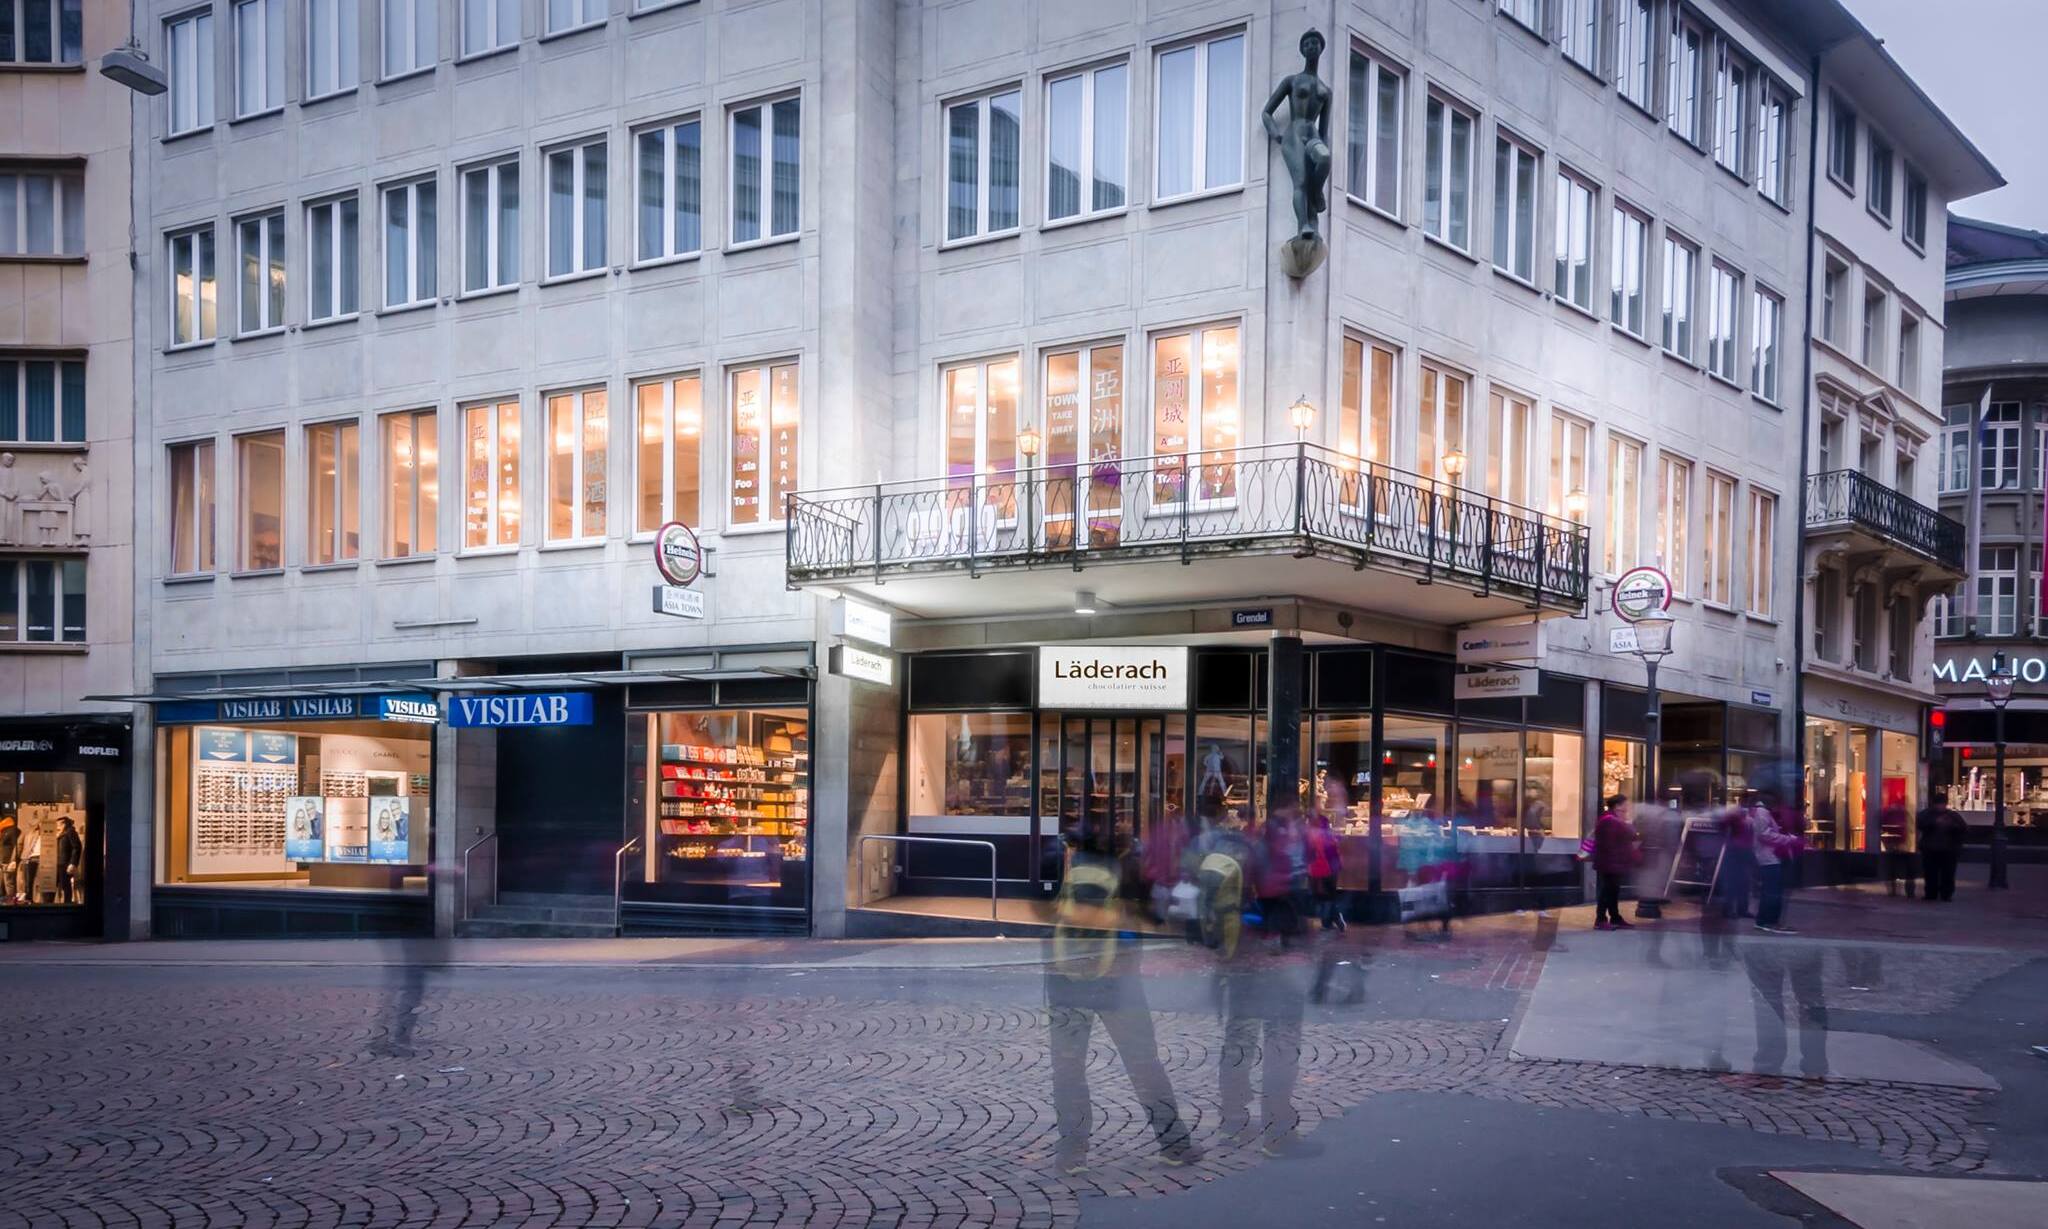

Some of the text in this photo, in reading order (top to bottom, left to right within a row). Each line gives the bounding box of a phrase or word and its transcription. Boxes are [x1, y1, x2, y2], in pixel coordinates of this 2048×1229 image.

[1162, 357, 1184, 424] 亚洲城
[1048, 393, 1079, 408] TOWN
[1052, 411, 1073, 420] TAKE
[1091, 369, 1121, 473] 亞洲城
[1051, 425, 1073, 435] AWAY
[779, 370, 789, 515] REAURANT
[664, 601, 703, 615] ASIA TOWN
[1237, 612, 1267, 624] Grendel
[1613, 641, 1633, 649] ASIA
[1055, 660, 1167, 679] Läderach
[1931, 657, 2047, 683] MAIO
[1467, 674, 1521, 688] Läderach
[223, 700, 281, 718] VISILAB
[292, 698, 353, 716] VISILAB
[386, 699, 438, 717] VISILAB
[460, 696, 569, 725] VISILAB
[79, 746, 119, 756] KOFLER
